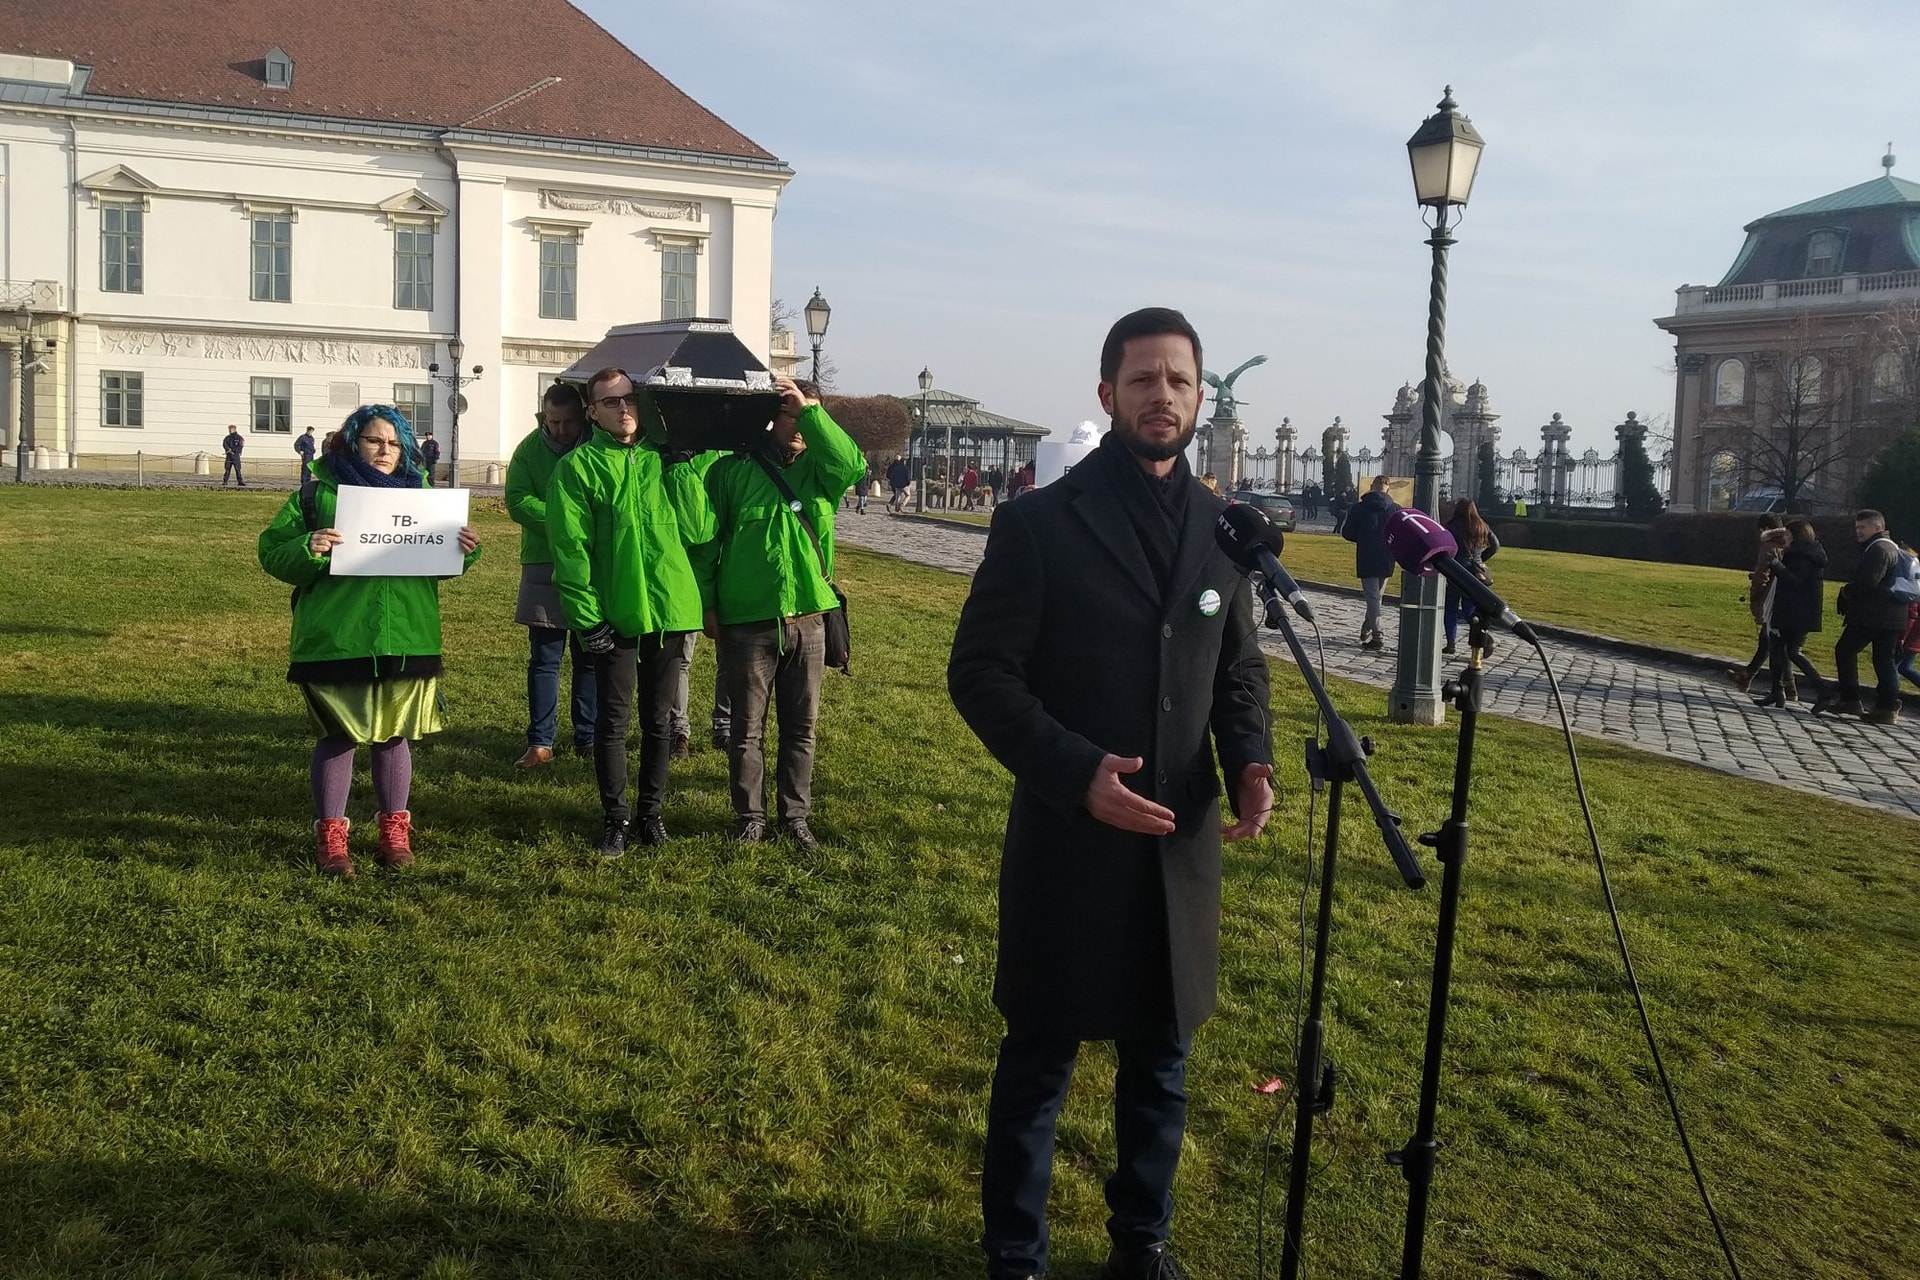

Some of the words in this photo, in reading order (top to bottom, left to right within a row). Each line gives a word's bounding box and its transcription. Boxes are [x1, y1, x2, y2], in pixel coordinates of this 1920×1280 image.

[391, 514, 418, 527] TB-
[1218, 514, 1238, 542] RTL
[359, 532, 444, 545] SZIGORÍTÁS
